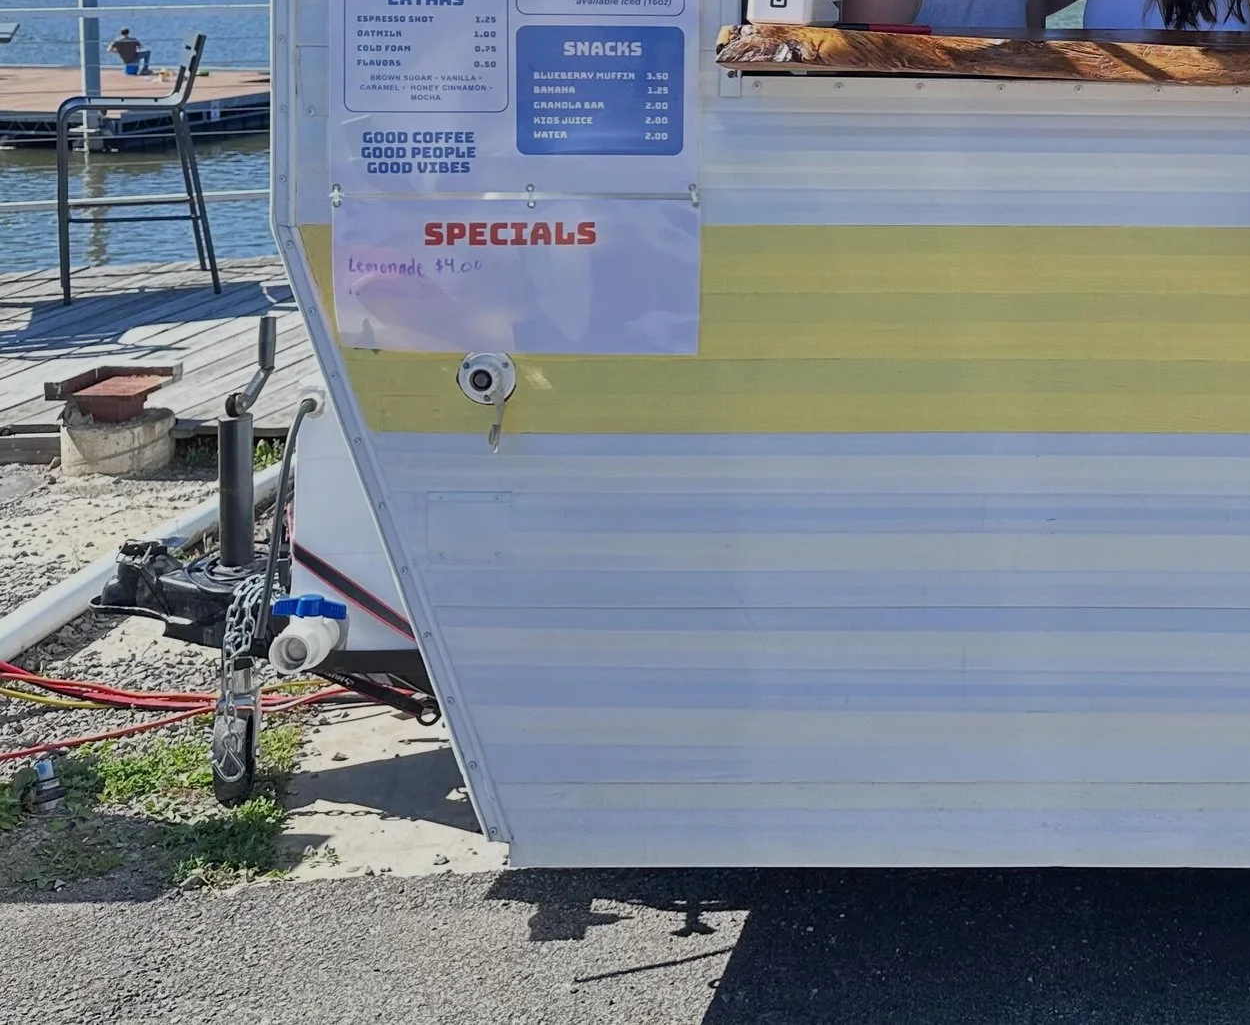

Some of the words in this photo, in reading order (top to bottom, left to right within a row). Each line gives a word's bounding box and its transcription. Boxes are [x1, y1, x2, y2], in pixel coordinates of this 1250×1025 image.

[357, 15, 406, 23] ESPRESSO
[357, 44, 382, 52] COLD
[475, 45, 496, 53] 0.75
[563, 41, 642, 57] SNACKS
[357, 59, 401, 67] FLAVORS
[474, 60, 496, 68] 0.50
[533, 72, 594, 80] BLUEBERRY
[596, 72, 635, 80] MUFFIN
[646, 72, 669, 80] 3.50
[533, 86, 575, 94] BANANA
[533, 101, 581, 109] GRANOLA
[583, 101, 604, 109] BAR
[645, 102, 669, 110] 2.00
[645, 116, 669, 124] 2.00
[362, 131, 408, 144] GOOD
[412, 131, 475, 144] COFFEE
[533, 131, 568, 139] WATER
[645, 132, 668, 140] 2.00
[361, 146, 407, 159] GOOD
[411, 146, 476, 159] PEOPLE
[367, 161, 412, 174] GOOD
[417, 161, 471, 174] VIBES
[424, 221, 597, 247] SPECIALS
[348, 258, 423, 277] Lemonade
[435, 258, 484, 274] $4.00
